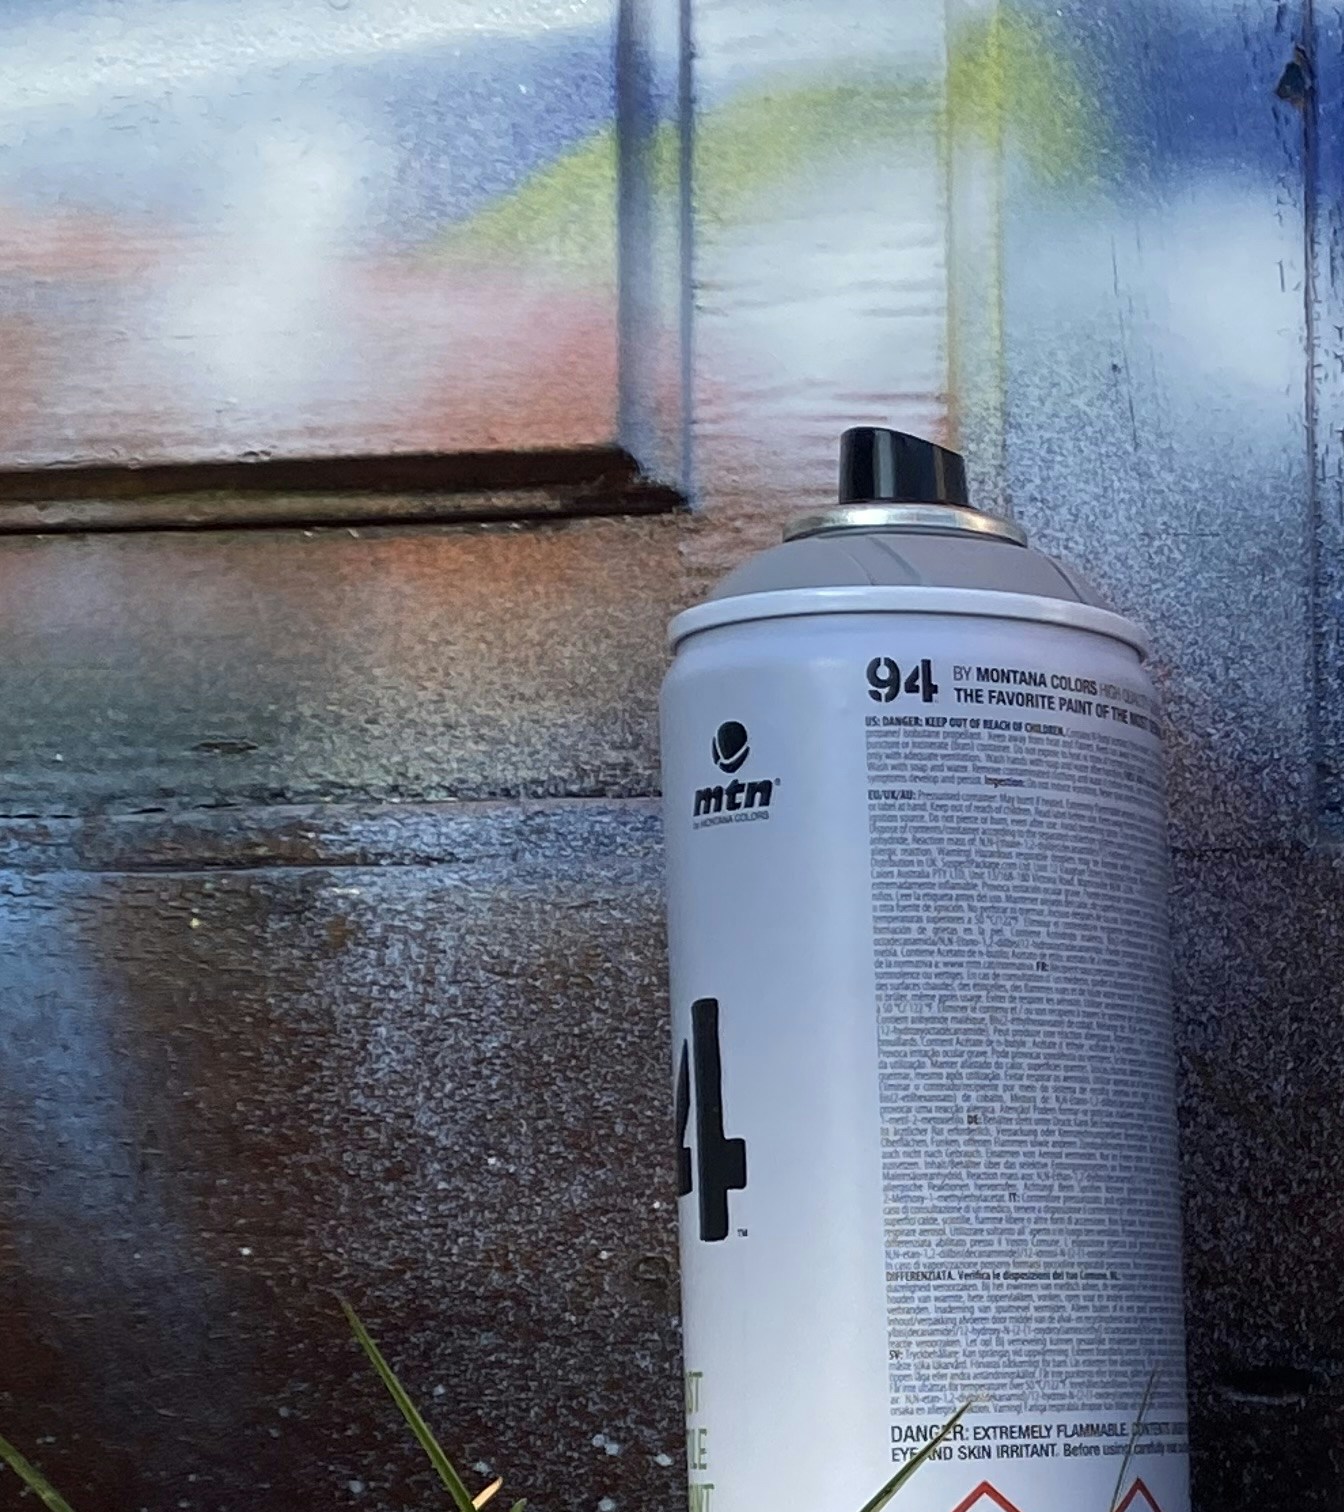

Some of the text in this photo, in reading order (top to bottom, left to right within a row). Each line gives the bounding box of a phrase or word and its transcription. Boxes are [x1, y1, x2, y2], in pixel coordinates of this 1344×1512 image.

[866, 656, 939, 703] 94
[953, 665, 1098, 696] BY MONTANA COLORS
[954, 687, 984, 704] THE
[987, 689, 1056, 711] FAVORITE
[1058, 696, 1093, 717] PAINT
[1095, 702, 1110, 721] OF
[882, 716, 923, 728] DANGER:
[924, 716, 948, 728] KEEP
[949, 716, 968, 729] OUT
[969, 717, 981, 730] OF
[982, 719, 1011, 732] REACH
[1012, 720, 1024, 732] OF
[693, 778, 773, 817] mtn
[889, 1423, 970, 1443] DANGER:
[973, 1424, 1054, 1441] EXTREMELY
[957, 1444, 993, 1460] SKIN
[996, 1442, 1061, 1459] IRRITANT.
[1063, 1442, 1101, 1457] Before
